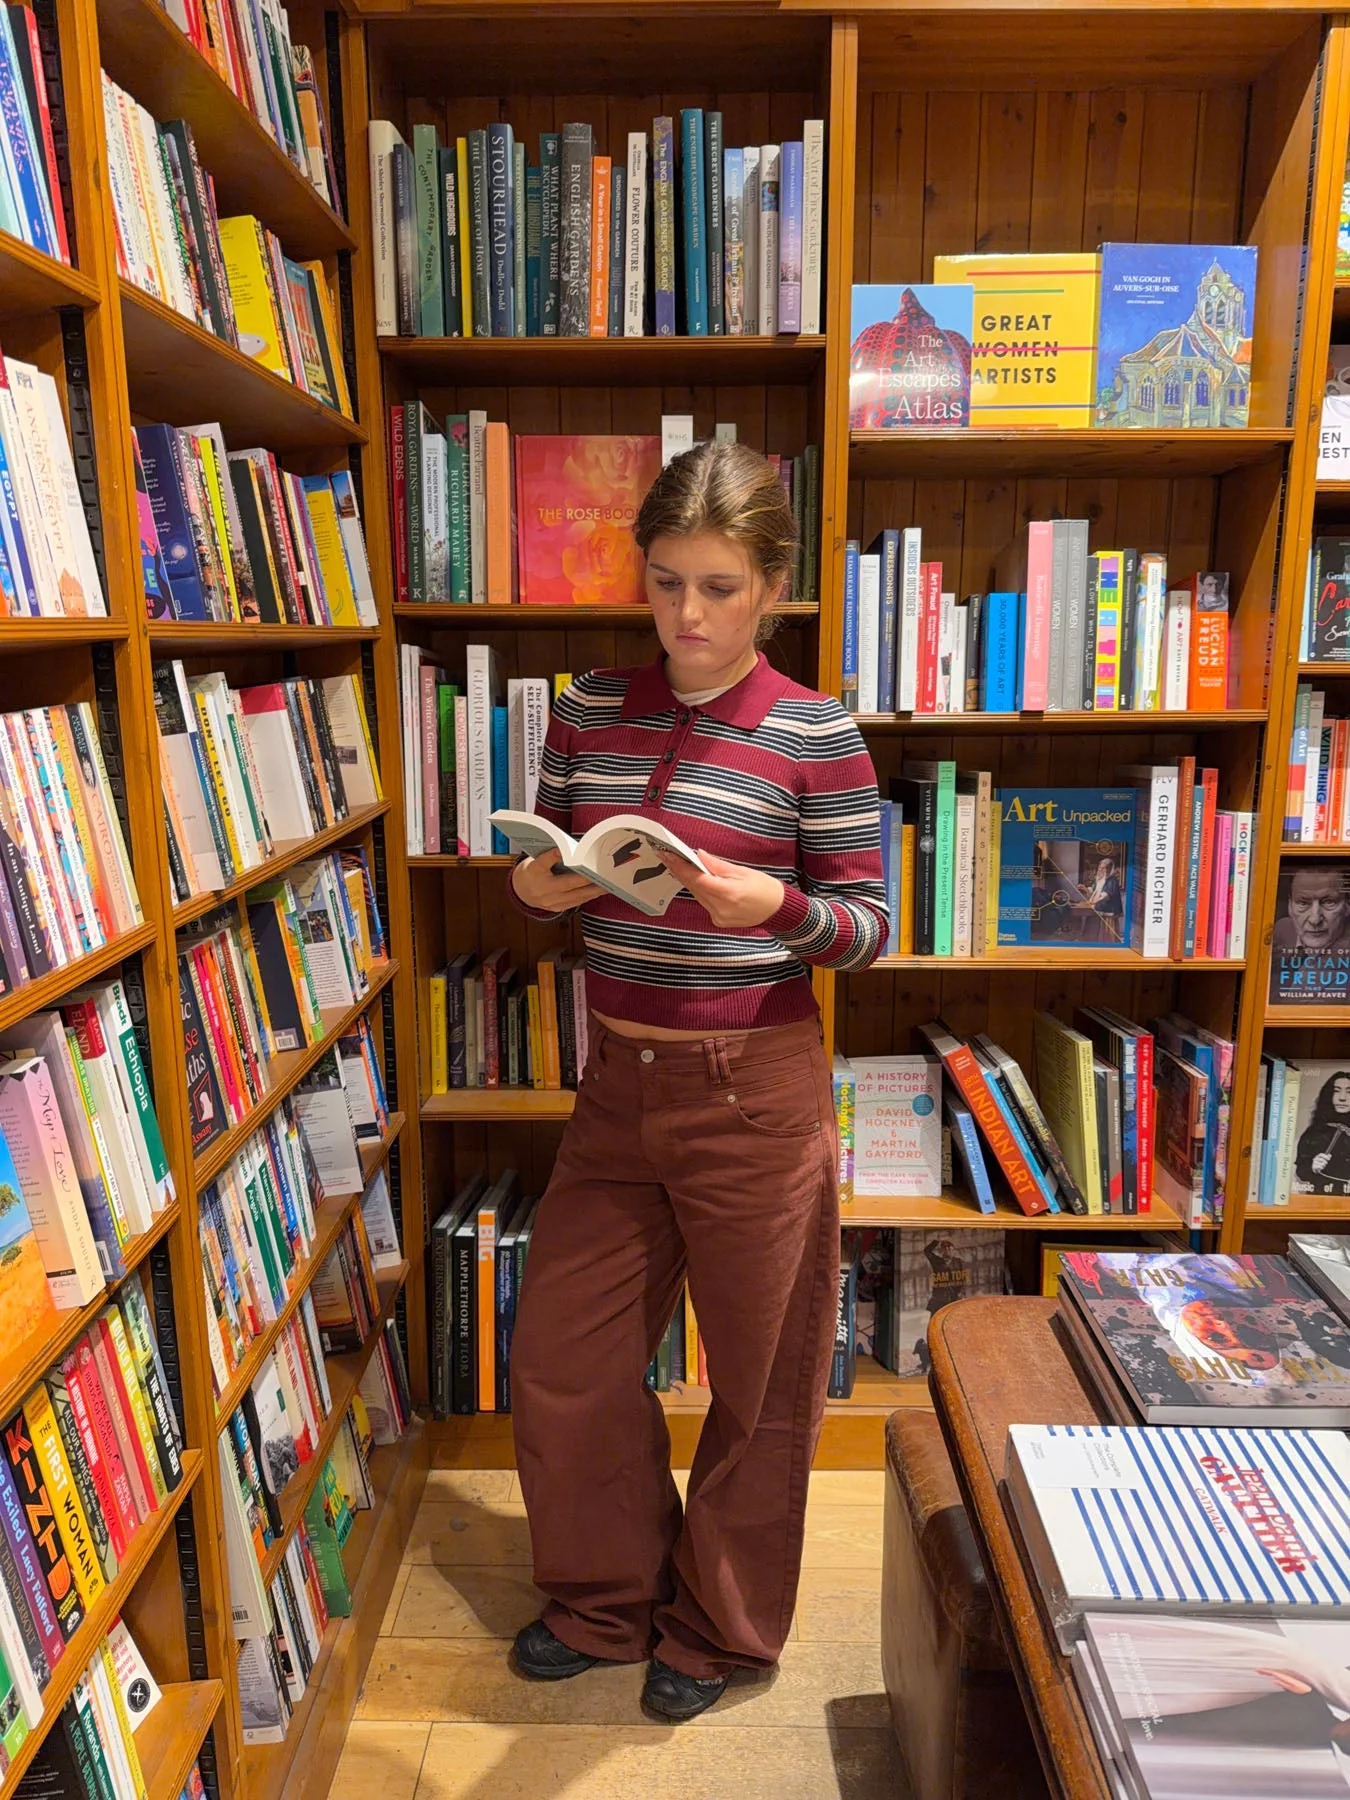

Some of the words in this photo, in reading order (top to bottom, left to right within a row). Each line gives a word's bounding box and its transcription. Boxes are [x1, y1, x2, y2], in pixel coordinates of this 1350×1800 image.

[473, 141, 481, 160] THE
[659, 142, 668, 157] The
[445, 173, 455, 191] WILD
[473, 165, 483, 225] LANDSCAPE
[491, 136, 506, 255] STOURHEAD
[550, 165, 558, 199] WHAT
[571, 164, 581, 226] ENGLISH
[659, 161, 668, 196] ENGLISH
[418, 165, 436, 236] CONTEMPORARY
[446, 192, 456, 236] NEIGHBOURS
[542, 165, 550, 238] ENCYCLOPEDIA
[631, 187, 640, 225] FLOWER
[474, 229, 482, 241] OF
[550, 202, 558, 238] PLANT
[659, 199, 669, 252] GARDENER'S
[425, 245, 435, 281] GARDEN
[475, 245, 484, 277] HOME
[550, 242, 558, 280] WHERE
[569, 230, 580, 296] GARDENS
[630, 229, 639, 272] COUTURE
[495, 260, 505, 287] Dudley
[661, 256, 669, 291] GARDEN
[1112, 284, 1180, 292] AUVERS-SUR-OISE
[1122, 275, 1137, 283] VAN
[1138, 275, 1160, 283] GOGH
[498, 289, 506, 310] Dodd
[981, 314, 1052, 332] GREAT
[918, 334, 943, 348] The
[972, 340, 1059, 358] WOMEN
[904, 351, 934, 367] Art
[971, 367, 1057, 384] ARTISTS
[878, 369, 961, 389] Escapes
[407, 404, 416, 439] ROYAL
[893, 395, 963, 420] Atlas
[393, 414, 403, 441] WILD
[394, 446, 404, 480] EDENS
[408, 441, 418, 490] GARDENS
[451, 470, 459, 524] RICHARD
[539, 508, 563, 520] THE
[566, 508, 601, 520] ROSE
[604, 508, 640, 519] BOO
[411, 505, 419, 543] WORLD
[452, 529, 460, 568] MABEY
[907, 541, 917, 575] INSIDERS
[886, 541, 895, 605] EXPRESSIONISTS
[930, 572, 938, 585] Art
[906, 577, 917, 617] OUTSIDERS
[929, 587, 937, 610] Fraud
[998, 631, 1006, 661] YEARS
[1198, 618, 1208, 666] FREUD
[1210, 617, 1220, 666] LUCIAN
[424, 676, 433, 694] The
[997, 677, 1006, 694] ART
[998, 663, 1006, 675] OF
[425, 697, 434, 730] Writer's
[473, 669, 484, 736] GLORIOUS
[527, 686, 536, 777] SELF-SUFFICIENCY
[534, 704, 542, 743] Complete
[200, 707, 216, 753] DON'T
[213, 761, 224, 788] LET
[222, 796, 231, 818] GO
[426, 732, 435, 764] Garden
[1320, 726, 1332, 764] WILD
[475, 740, 486, 801] GARDENS
[1317, 769, 1328, 803] THING
[90, 793, 112, 859] CAIRO
[941, 811, 950, 843] Drawing
[1002, 796, 1058, 822] Art
[1062, 810, 1131, 824] Unpacked
[1194, 801, 1202, 830] ANDREW
[1156, 795, 1169, 861] GERHARD
[1192, 832, 1200, 859] FESTING
[7, 842, 14, 857] In
[11, 857, 19, 873] an
[959, 827, 970, 871] Botanical
[1238, 823, 1248, 876] HOCKNEY
[1189, 879, 1198, 898] VALUE
[1191, 864, 1199, 878] FACE
[14, 875, 33, 923] Antique
[958, 874, 969, 934] Sketchbooks
[1152, 866, 1168, 924] RICHTER
[28, 922, 41, 955] Land
[1280, 971, 1348, 984] FREUD
[1281, 956, 1350, 968] LUCIAN
[111, 984, 128, 1027] Bradt
[125, 1037, 148, 1112] Ethiopia
[858, 1084, 873, 1092] OF
[878, 1084, 933, 1092] PICTURES
[865, 1073, 872, 1081] A
[878, 1072, 926, 1081] HISTORY
[840, 1079, 851, 1137] Hockney's
[865, 1119, 922, 1128] HOCKNEY
[876, 1109, 912, 1117] DAVID
[37, 1090, 55, 1135] Map
[52, 1149, 71, 1194] Love
[865, 1151, 922, 1159] GAYFORD
[872, 1140, 917, 1148] MARTIN
[970, 1087, 1010, 1156] INDIAN
[1004, 1159, 1036, 1194] ART
[839, 1139, 850, 1184] Pictures
[262, 1168, 275, 1212] Namibia
[274, 1146, 288, 1191] Southern
[285, 1193, 296, 1222] Africa
[1293, 1182, 1315, 1193] Music
[1324, 1184, 1334, 1192] of
[248, 1190, 259, 1222] Angola
[479, 1225, 494, 1261] BIG
[459, 1249, 469, 1338] MAPPLETHORPE
[111, 1317, 129, 1367] KOLOLO
[124, 1368, 138, 1401] HILL
[460, 1342, 469, 1378] FLORA
[1168, 1355, 1252, 1380] DAYS
[150, 1374, 158, 1393] THE
[40, 1419, 53, 1439] THE
[63, 1409, 74, 1426] ALL
[154, 1392, 170, 1432] GHOSTS
[68, 1427, 80, 1450] OUR
[164, 1433, 173, 1446] OF
[43, 1435, 68, 1492] FIRST
[75, 1450, 92, 1485] NAMES
[168, 1445, 180, 1475] EDEN
[1195, 1487, 1228, 1534] CATWALK
[1199, 1456, 1306, 1575] GAULTIER
[1234, 1465, 1278, 1511] Jean
[1268, 1512, 1319, 1564] Paul
[63, 1492, 93, 1576] WOMAN
[1, 1487, 24, 1543] Exiled
[20, 1544, 37, 1586] Lucy
[31, 1582, 54, 1638] Fulford
